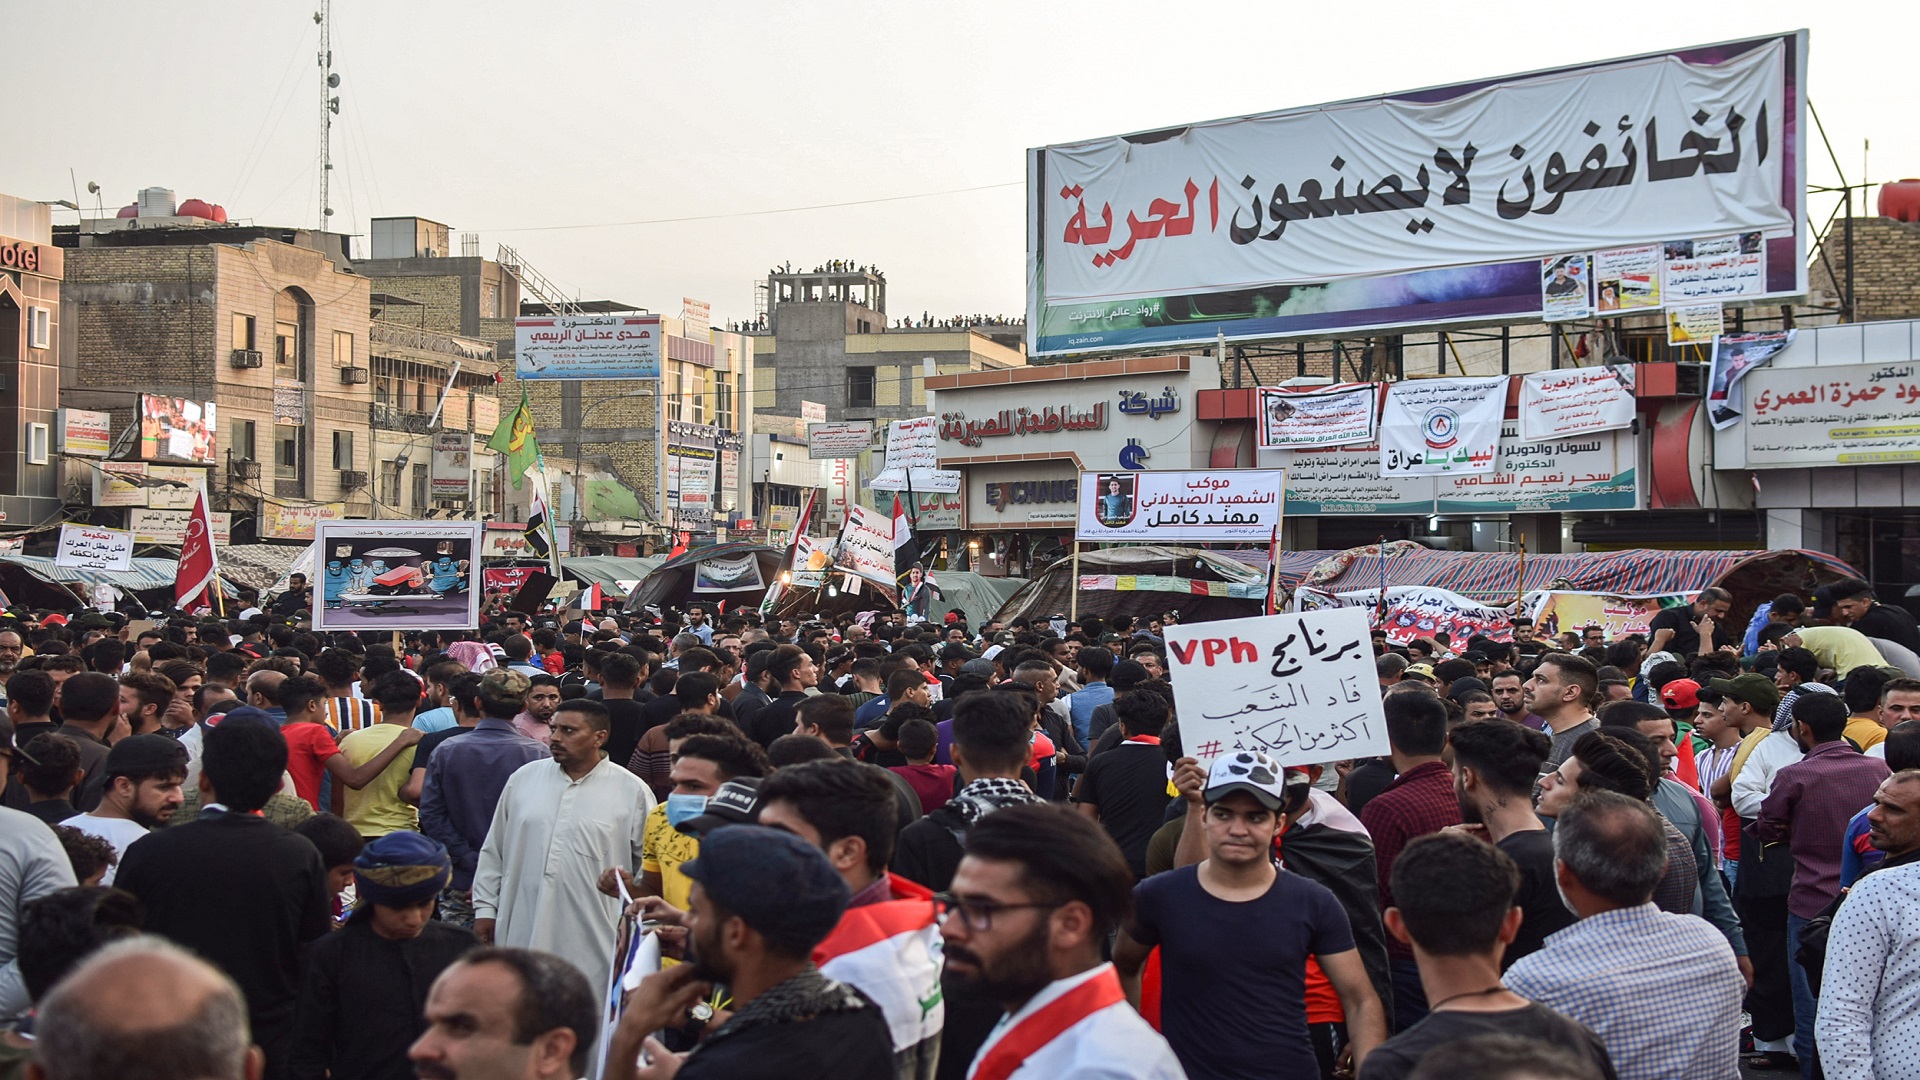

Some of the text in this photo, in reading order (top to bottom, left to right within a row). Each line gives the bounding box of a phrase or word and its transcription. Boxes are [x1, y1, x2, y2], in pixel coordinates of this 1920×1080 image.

[1496, 98, 1769, 216] الخائفون
[1062, 175, 1219, 268] الحرية
[562, 317, 616, 328] الدكتورة
[530, 328, 650, 343] هدى عدنان الربيعي
[1068, 335, 1104, 345] iq.zain.com
[1541, 367, 1618, 392] عشيرة الزهيرية
[1868, 366, 1914, 382] الدكتور
[1118, 386, 1181, 420] شركة
[1754, 384, 1825, 416] العمري
[1830, 382, 1886, 408] حمزة
[938, 400, 1109, 448] الساطعة للصيرفة
[1316, 434, 1337, 442] العراق
[1387, 444, 1495, 470] لبيك يا عراق
[1505, 442, 1601, 457] للسونار والدوبلر
[1293, 457, 1359, 469] امراض نسائية وتوليد
[1505, 459, 1555, 471] الدكتورة
[1187, 476, 1230, 492] موكب
[1291, 471, 1372, 482] والعقم وامراض المسالك
[1453, 472, 1611, 489] سحر نعيم الشامي
[986, 479, 1077, 512] EXCHANG
[1141, 490, 1275, 511] الشهيد الصيدلاني
[163, 512, 175, 525] علي
[1146, 509, 1259, 527] مهند كامل
[82, 530, 114, 540] الحكومة
[65, 539, 126, 552] مثل بطل العرك
[103, 553, 119, 562] منين
[1603, 602, 1648, 620] موكب
[1271, 618, 1362, 678] برنامج
